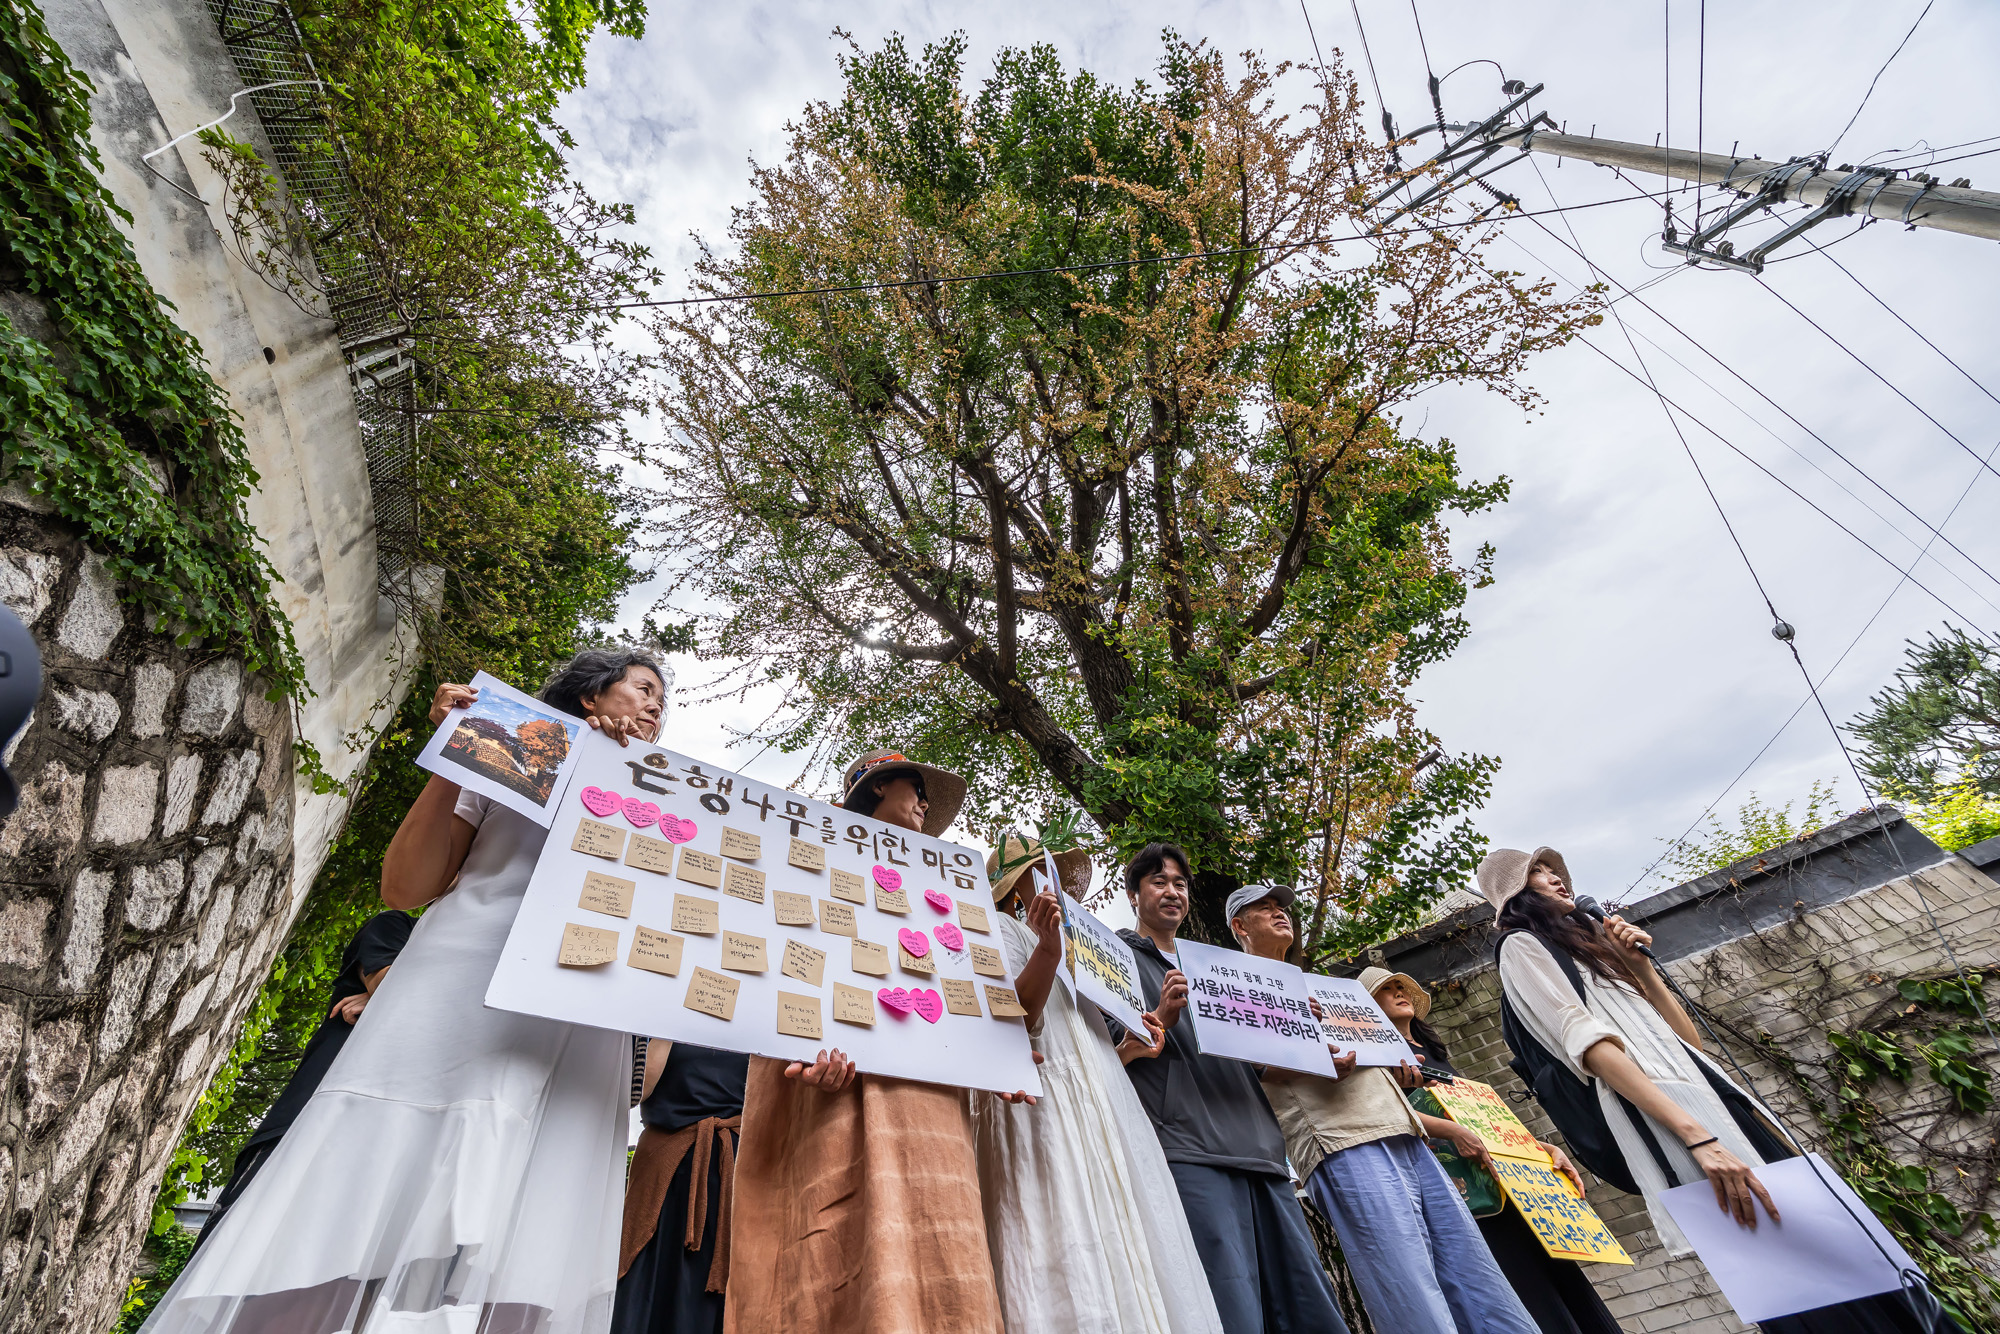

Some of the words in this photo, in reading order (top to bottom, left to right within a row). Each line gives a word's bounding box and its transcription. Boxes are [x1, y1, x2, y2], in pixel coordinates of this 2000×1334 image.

[624, 752, 837, 845] 은행나무를
[843, 824, 911, 867] 위한
[921, 847, 978, 890] 마음
[1078, 917, 1101, 942] 미술관
[1070, 924, 1132, 988] 기미술관은
[1210, 964, 1240, 980] 사유지
[1243, 971, 1263, 986] 핑계
[1266, 977, 1285, 991] 그만
[1074, 948, 1100, 978] 나무
[1102, 970, 1145, 1014] 살려내라
[1191, 977, 1246, 1003] 서울시는
[1248, 988, 1312, 1020] 은행나무를
[1314, 989, 1342, 1001] 은행나무
[1196, 1000, 1261, 1029] 보호수로
[1261, 1014, 1321, 1043] 지정하라
[1320, 1023, 1364, 1043] 책임있게
[1358, 1026, 1403, 1045] 복원하라
